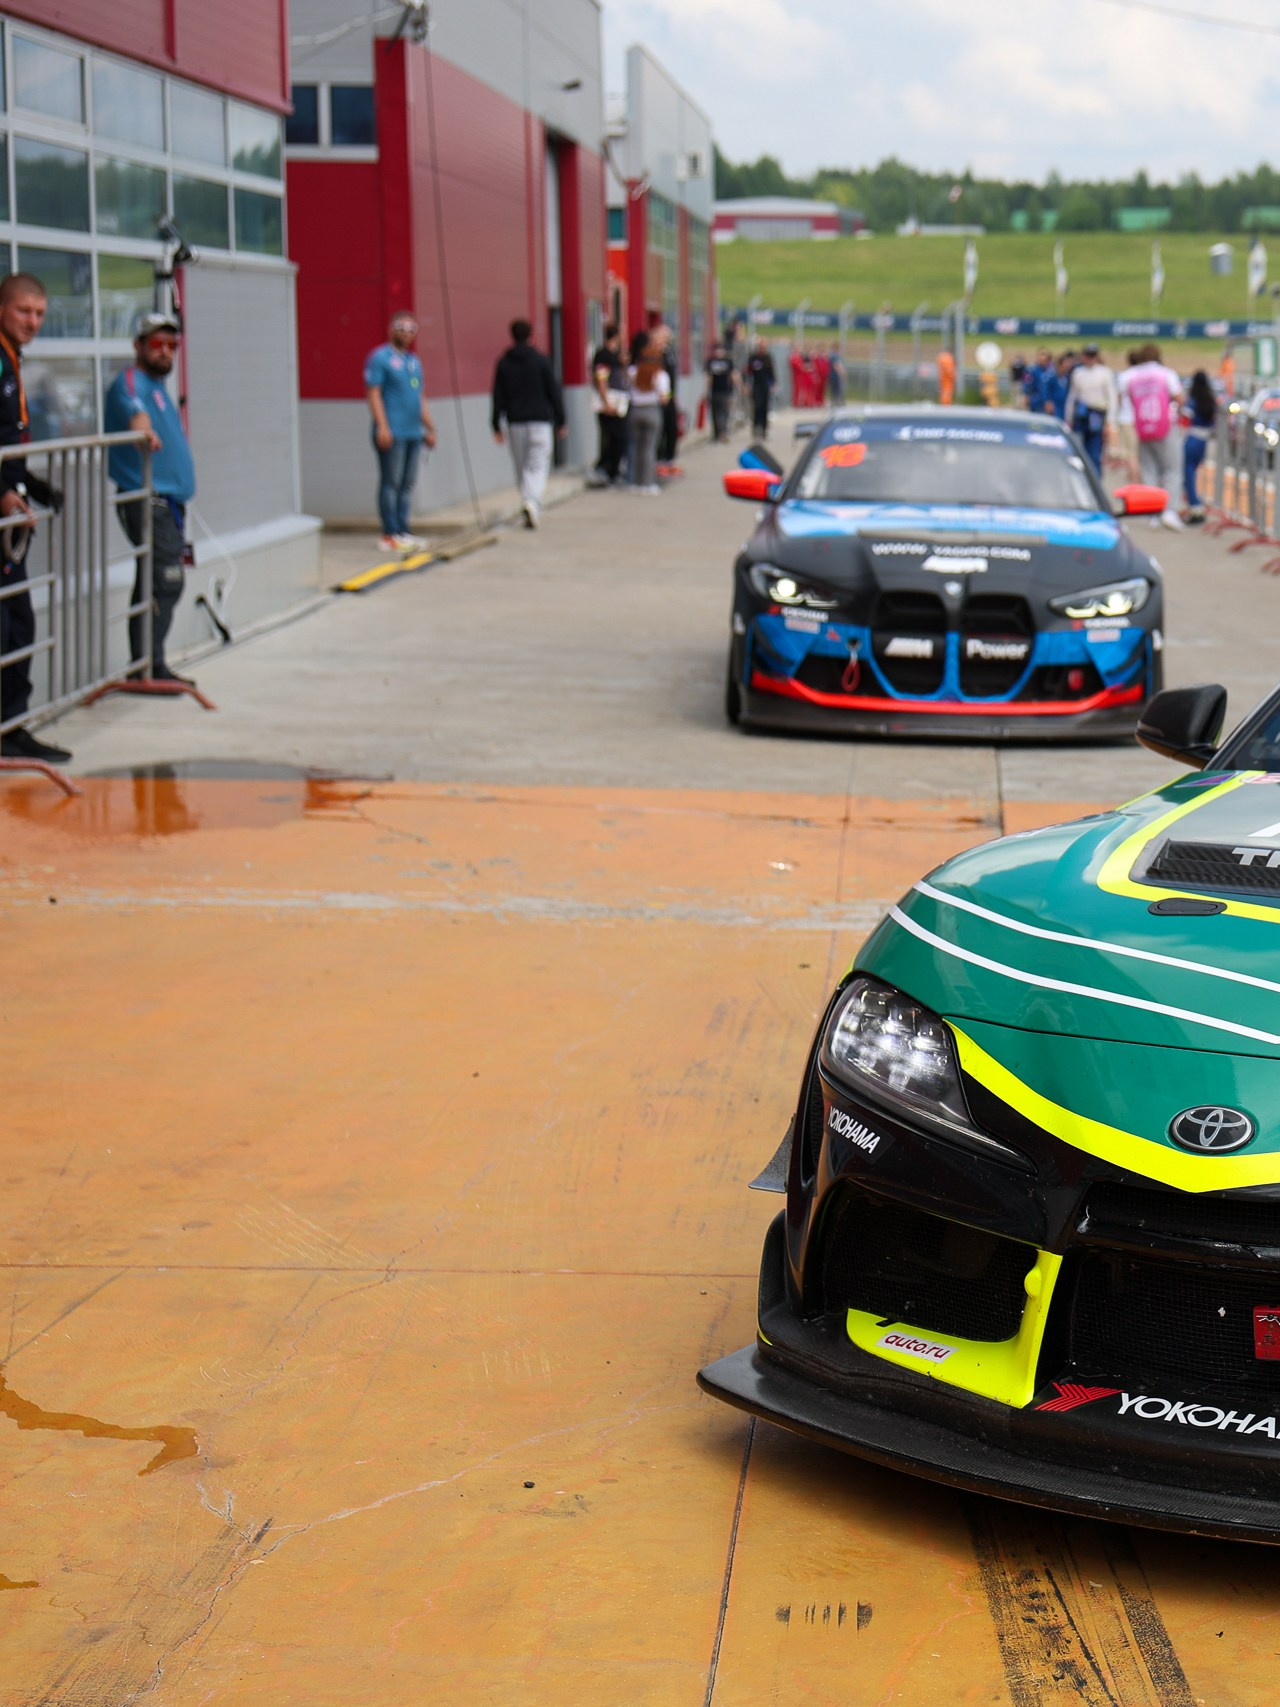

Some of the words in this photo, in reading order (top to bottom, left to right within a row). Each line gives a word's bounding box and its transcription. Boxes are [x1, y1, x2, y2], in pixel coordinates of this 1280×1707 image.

[966, 639, 1028, 660] Power
[827, 1105, 881, 1154] YOKOHAMA
[884, 1334, 950, 1358] auto.ru
